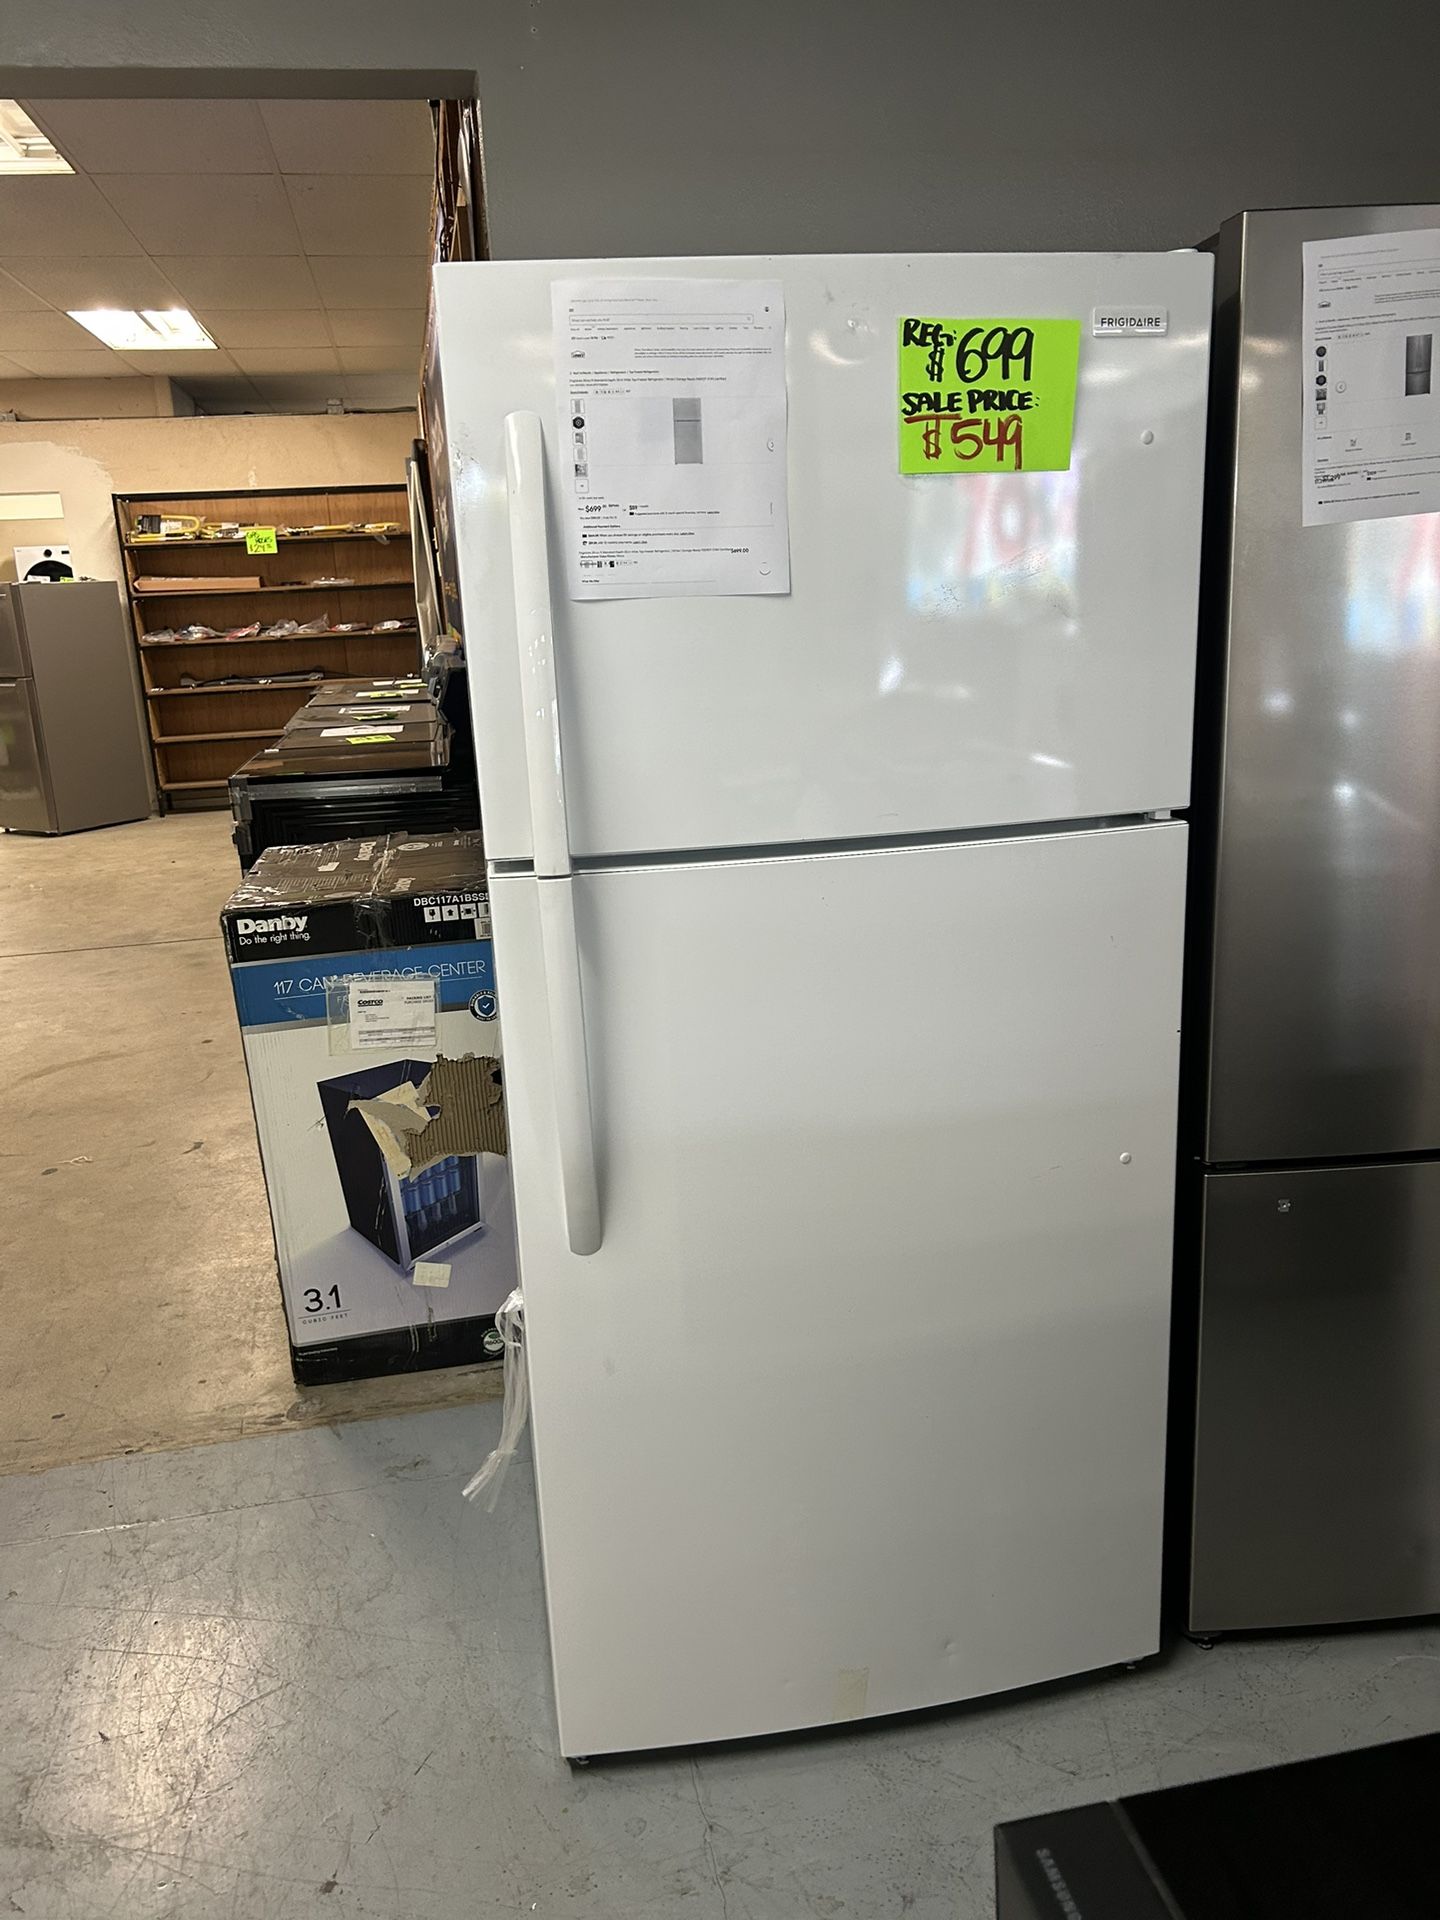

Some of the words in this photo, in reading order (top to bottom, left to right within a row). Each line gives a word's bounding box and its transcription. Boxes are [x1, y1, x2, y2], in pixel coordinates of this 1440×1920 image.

[1100, 317, 1161, 327] FRIGIDAIRE
[902, 391, 963, 416] SALE
[966, 389, 1040, 414] PRICE:
[236, 915, 308, 935] Danby
[239, 936, 252, 946] Do
[254, 934, 268, 944] the
[270, 932, 288, 944] right
[273, 979, 294, 995] 117
[427, 959, 487, 979] CENTER
[303, 1284, 341, 1312] 3.1
